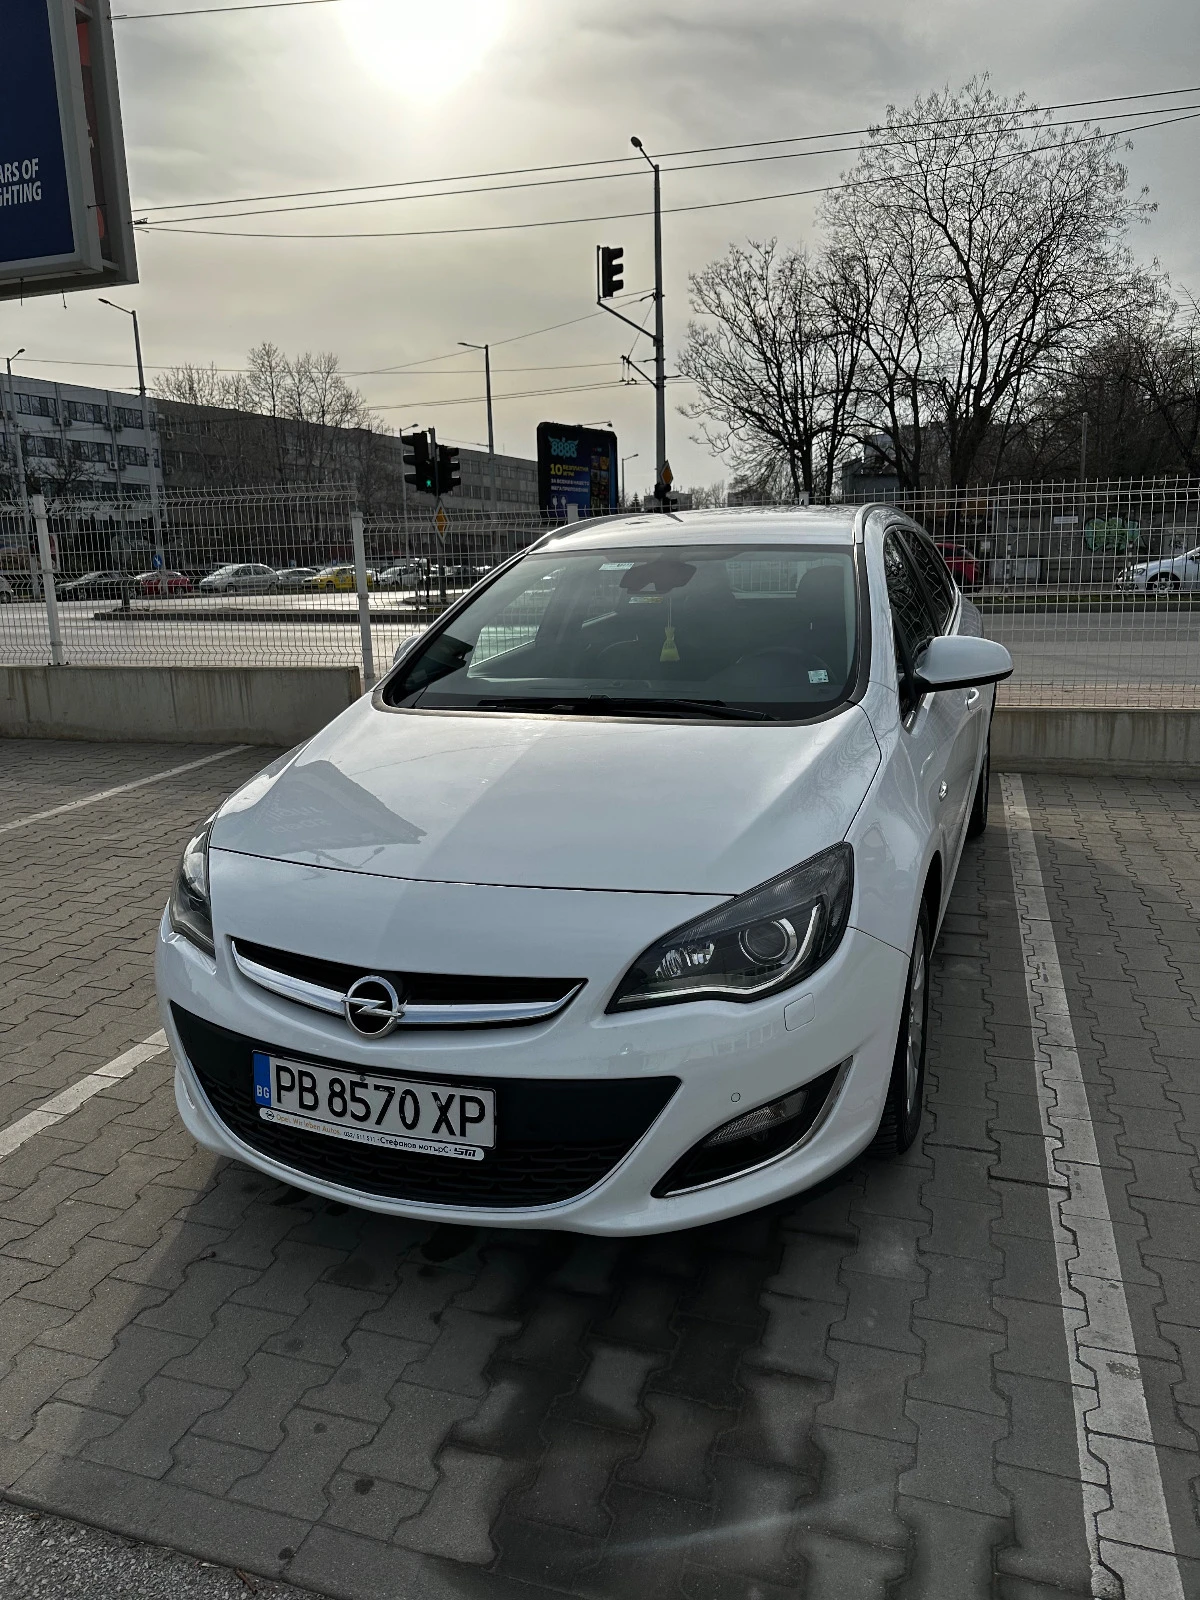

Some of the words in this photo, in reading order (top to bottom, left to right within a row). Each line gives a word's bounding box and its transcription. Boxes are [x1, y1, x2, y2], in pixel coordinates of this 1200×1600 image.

[22, 157, 39, 180] OF
[551, 441, 577, 457] 8888
[550, 464, 562, 475] 10
[256, 1084, 270, 1099] BG
[275, 1063, 319, 1112] PB
[327, 1076, 421, 1131] 8570
[430, 1091, 486, 1138] XP
